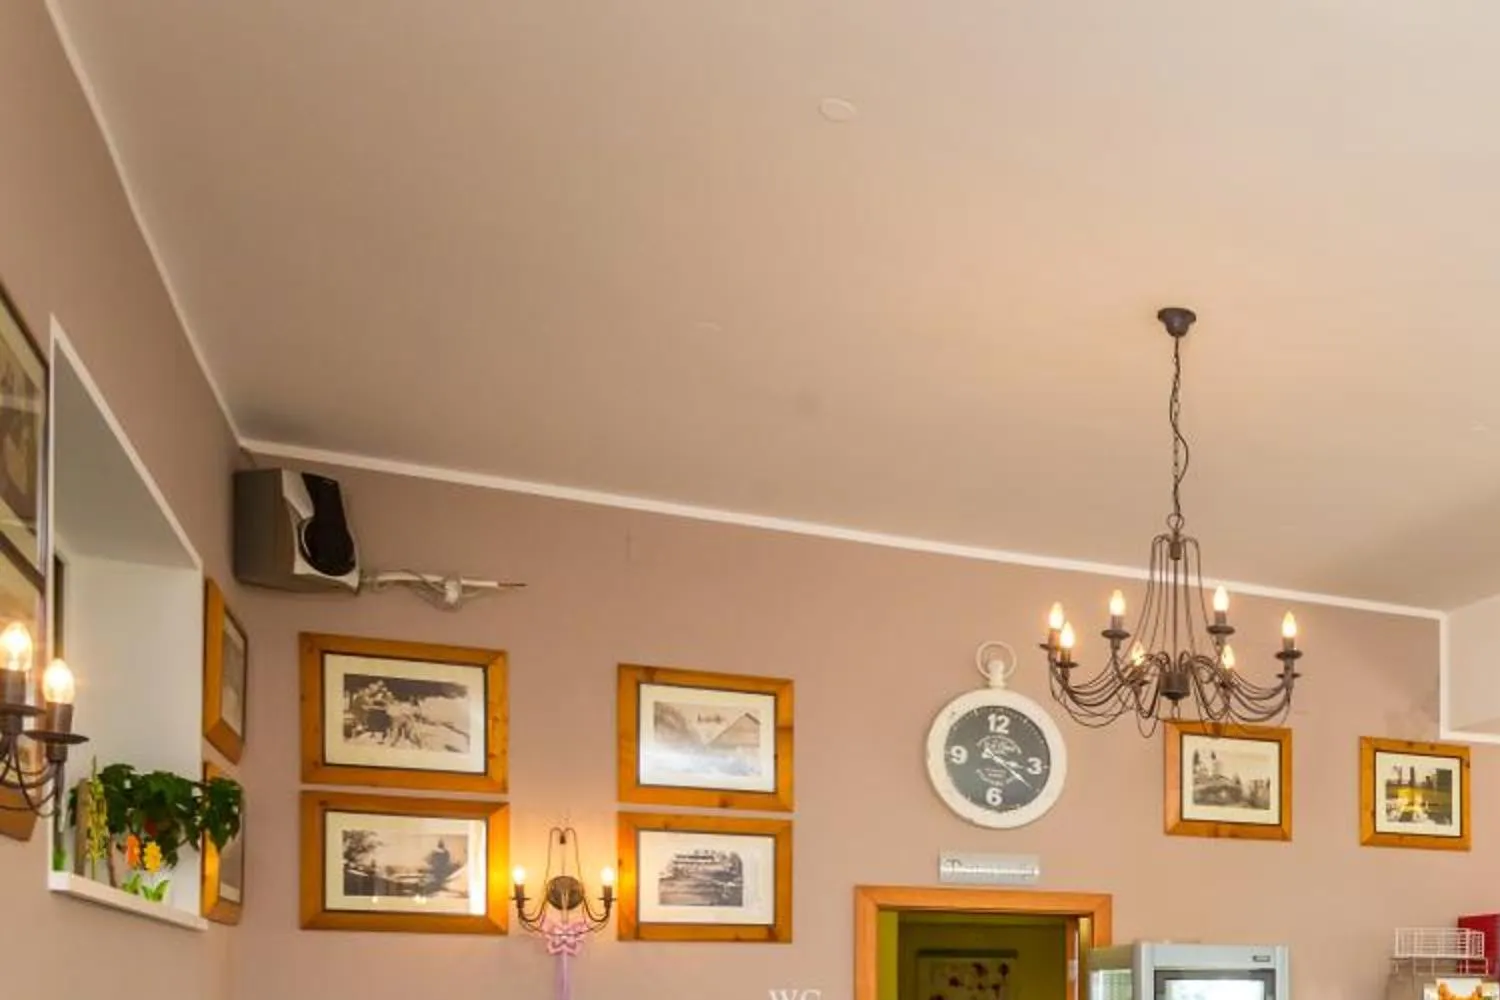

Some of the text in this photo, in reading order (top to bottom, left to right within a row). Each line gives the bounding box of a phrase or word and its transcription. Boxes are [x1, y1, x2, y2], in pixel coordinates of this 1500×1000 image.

[987, 713, 1010, 734] 12
[950, 745, 968, 765] 9
[1026, 757, 1042, 775] 3
[985, 787, 1003, 807] 6
